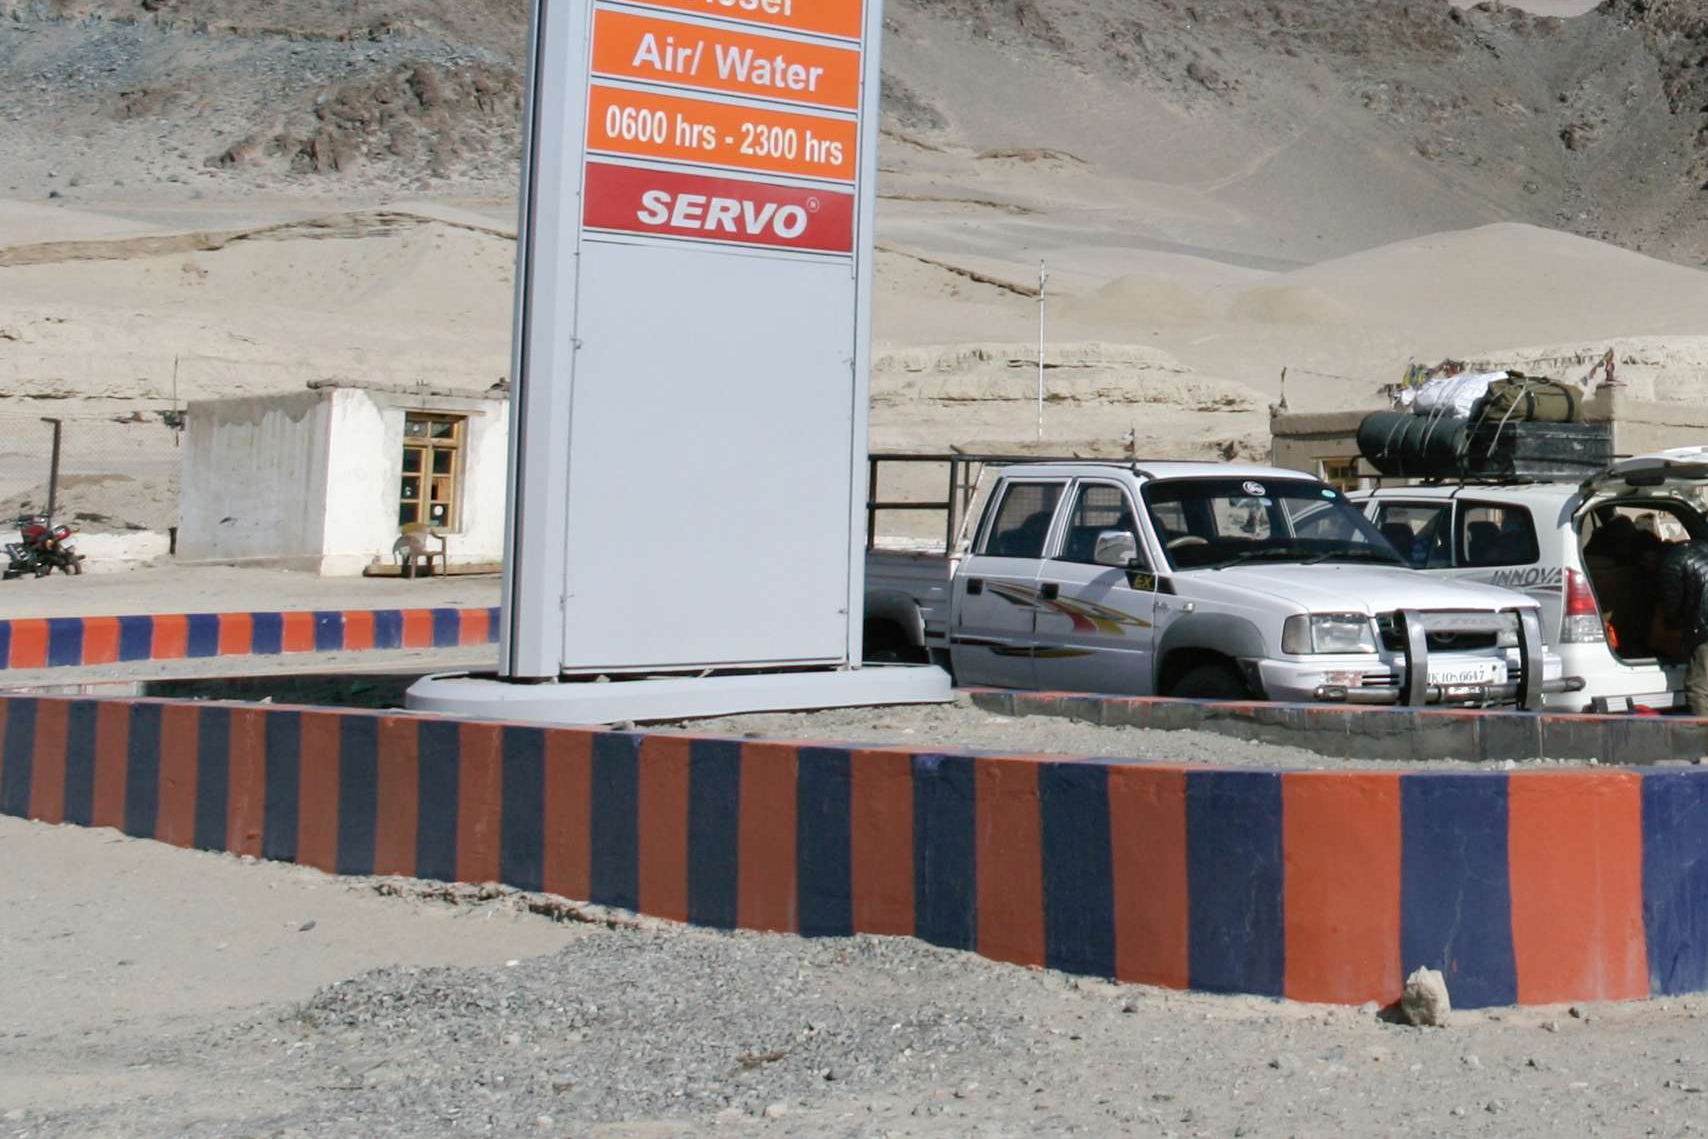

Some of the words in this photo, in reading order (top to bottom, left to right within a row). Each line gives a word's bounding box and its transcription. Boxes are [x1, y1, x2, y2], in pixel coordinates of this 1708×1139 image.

[632, 33, 704, 75] Air/
[715, 44, 824, 92] Water
[606, 105, 667, 144] 0600
[675, 114, 717, 150] hrs
[740, 122, 797, 159] 2300
[804, 130, 843, 165] hrs
[1492, 567, 1563, 587] INNOVA
